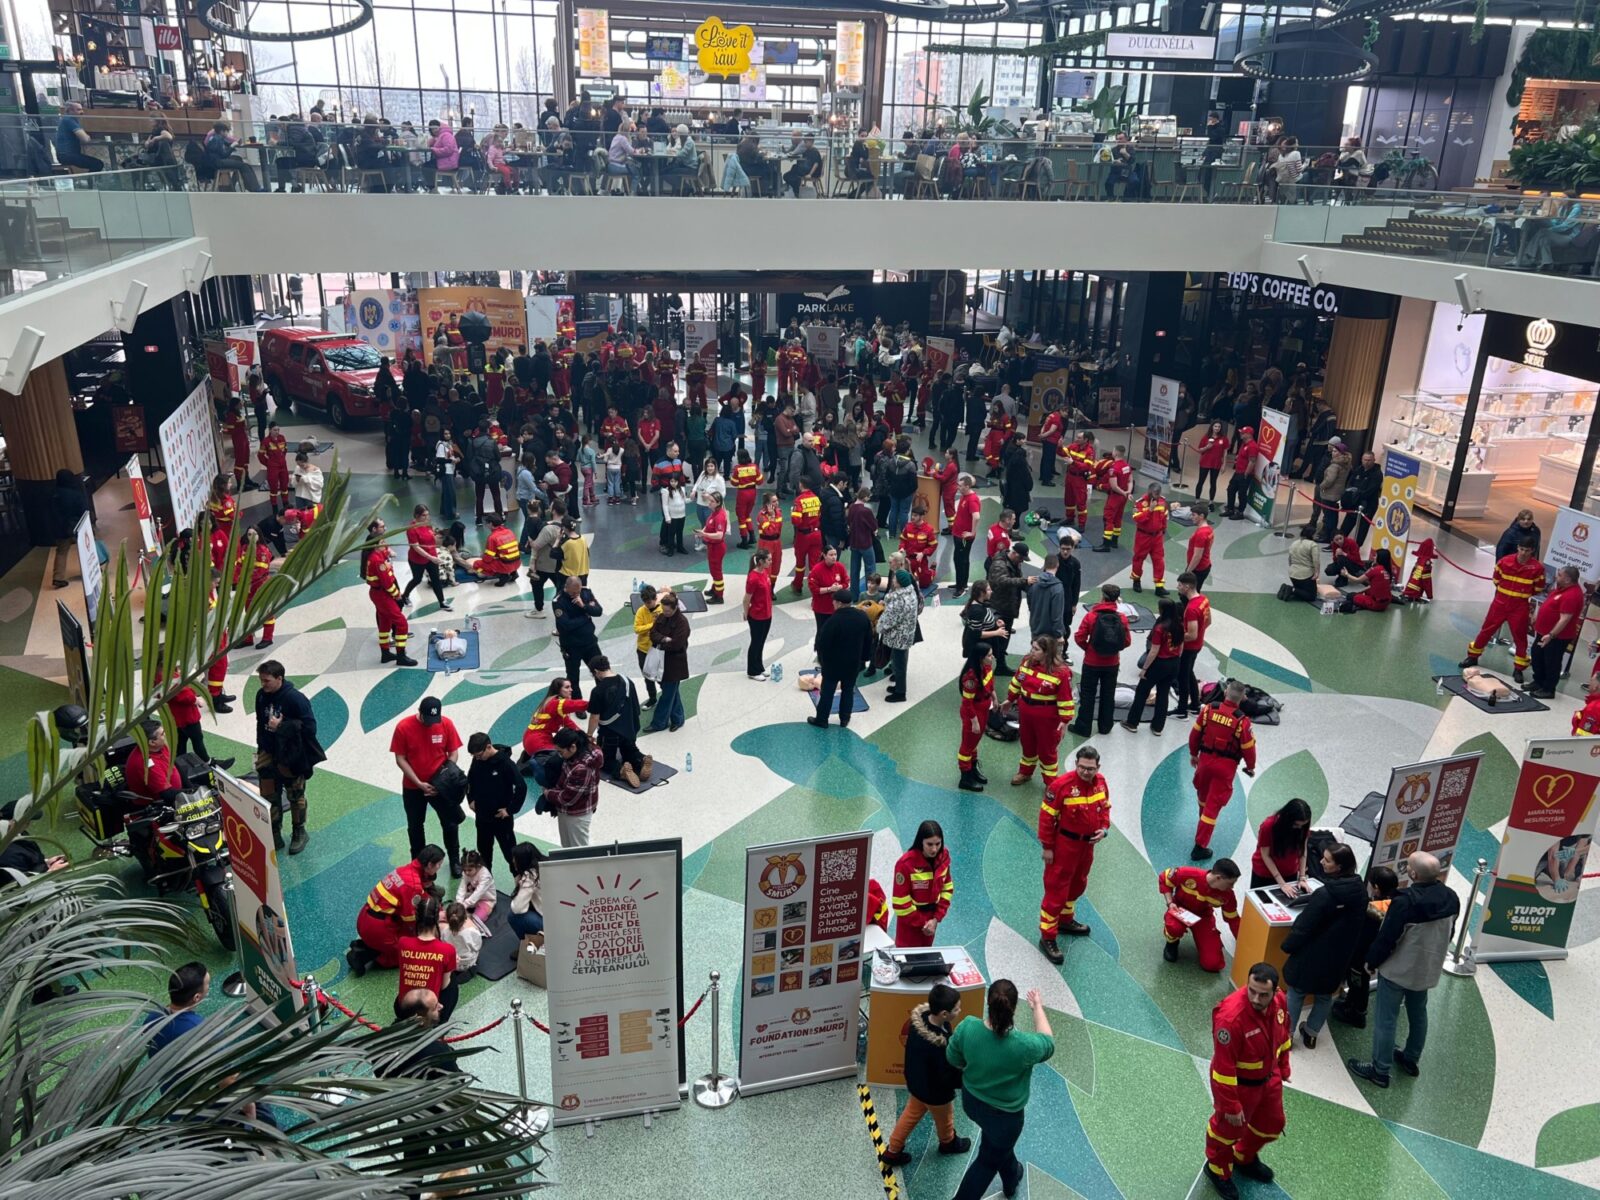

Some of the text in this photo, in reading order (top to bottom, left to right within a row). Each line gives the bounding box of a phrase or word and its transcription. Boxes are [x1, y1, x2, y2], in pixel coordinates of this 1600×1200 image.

[158, 30, 178, 48] illy
[700, 25, 749, 48] Love it
[714, 52, 738, 66] raw
[1227, 272, 1338, 313] TED'S COFFEE CO.
[1212, 713, 1232, 726] MEDIC
[766, 885, 798, 898] SMURD
[820, 888, 840, 896] Cine
[820, 891, 857, 904] salvează
[581, 904, 637, 916] ACORDAREA
[828, 901, 849, 910] viață
[1514, 906, 1529, 915] TU
[1529, 906, 1556, 918] POȚI
[819, 907, 857, 920] salvează
[1511, 915, 1544, 925] SALVA
[580, 921, 623, 933] PUBLICE
[578, 935, 643, 950] O DATORIE
[401, 950, 444, 962] VOLUNTAR
[577, 943, 644, 959] A STATULUI
[585, 958, 600, 966] UN
[604, 954, 633, 965] DREPT
[404, 971, 430, 980] PENTRU
[404, 979, 426, 987] SMURD
[750, 1028, 809, 1045] FOUNDATION
[813, 1022, 844, 1034] SMURD
